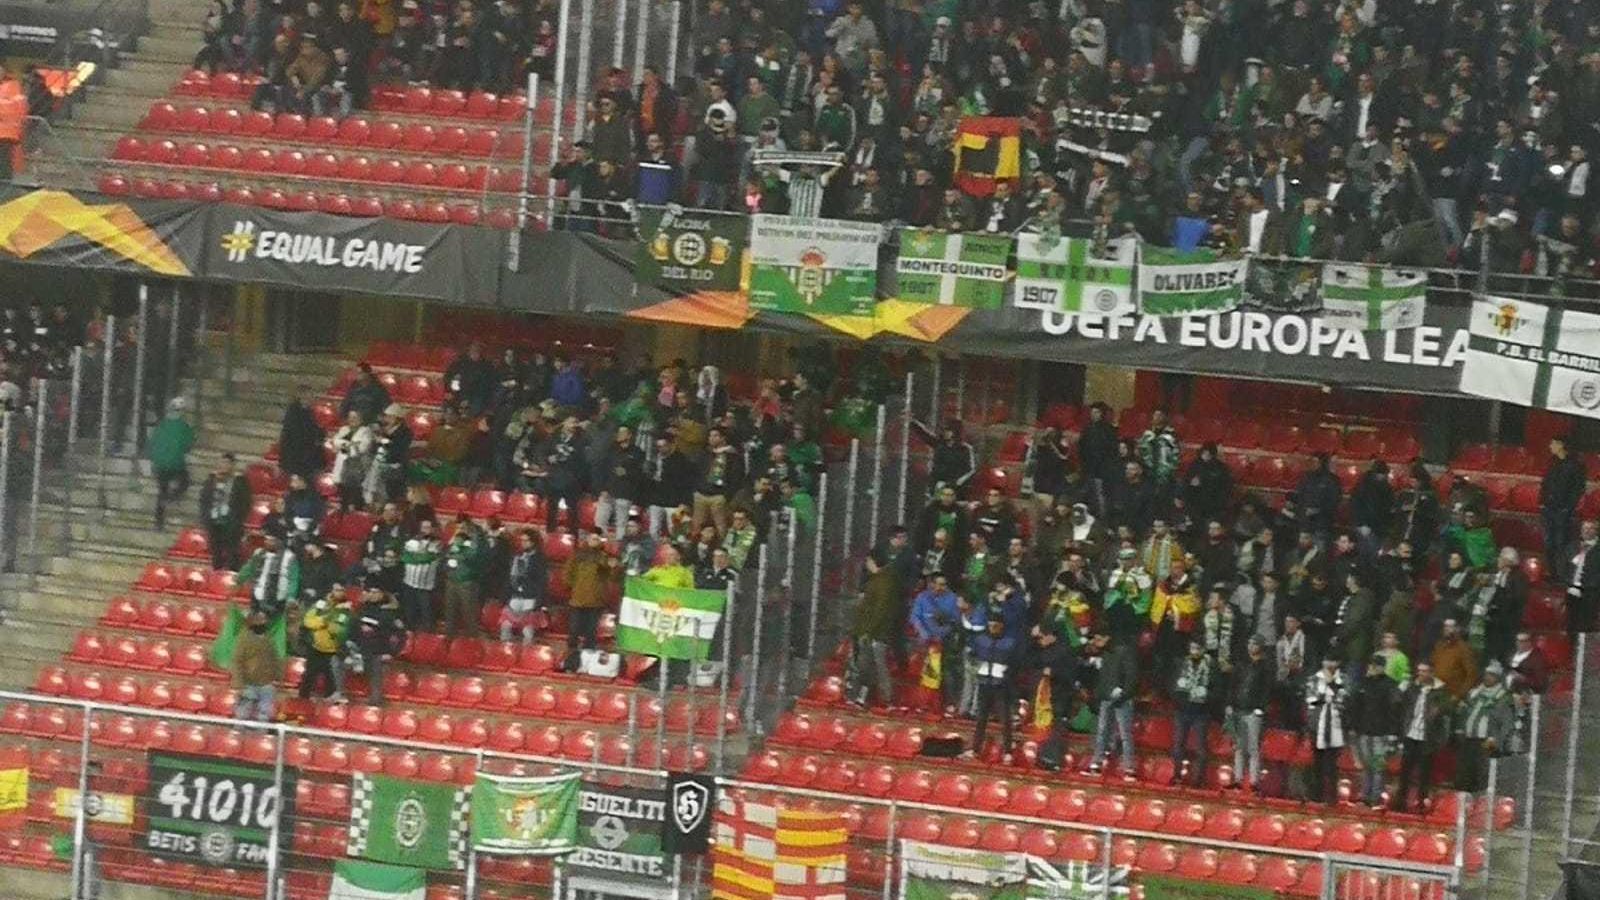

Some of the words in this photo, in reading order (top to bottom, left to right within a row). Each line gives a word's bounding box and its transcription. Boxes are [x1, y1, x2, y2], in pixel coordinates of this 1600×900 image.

[221, 221, 426, 273] #EQUALGAME
[661, 265, 688, 279] DEL
[901, 260, 1004, 279] MONTEQUINTO
[1023, 286, 1057, 303] 1907
[1042, 310, 1167, 343] UEFA
[1180, 311, 1370, 360] EUROPA
[1528, 348, 1545, 361] EL
[159, 772, 280, 828] 41010
[148, 830, 197, 852] BETIS
[236, 842, 281, 861] FAN
